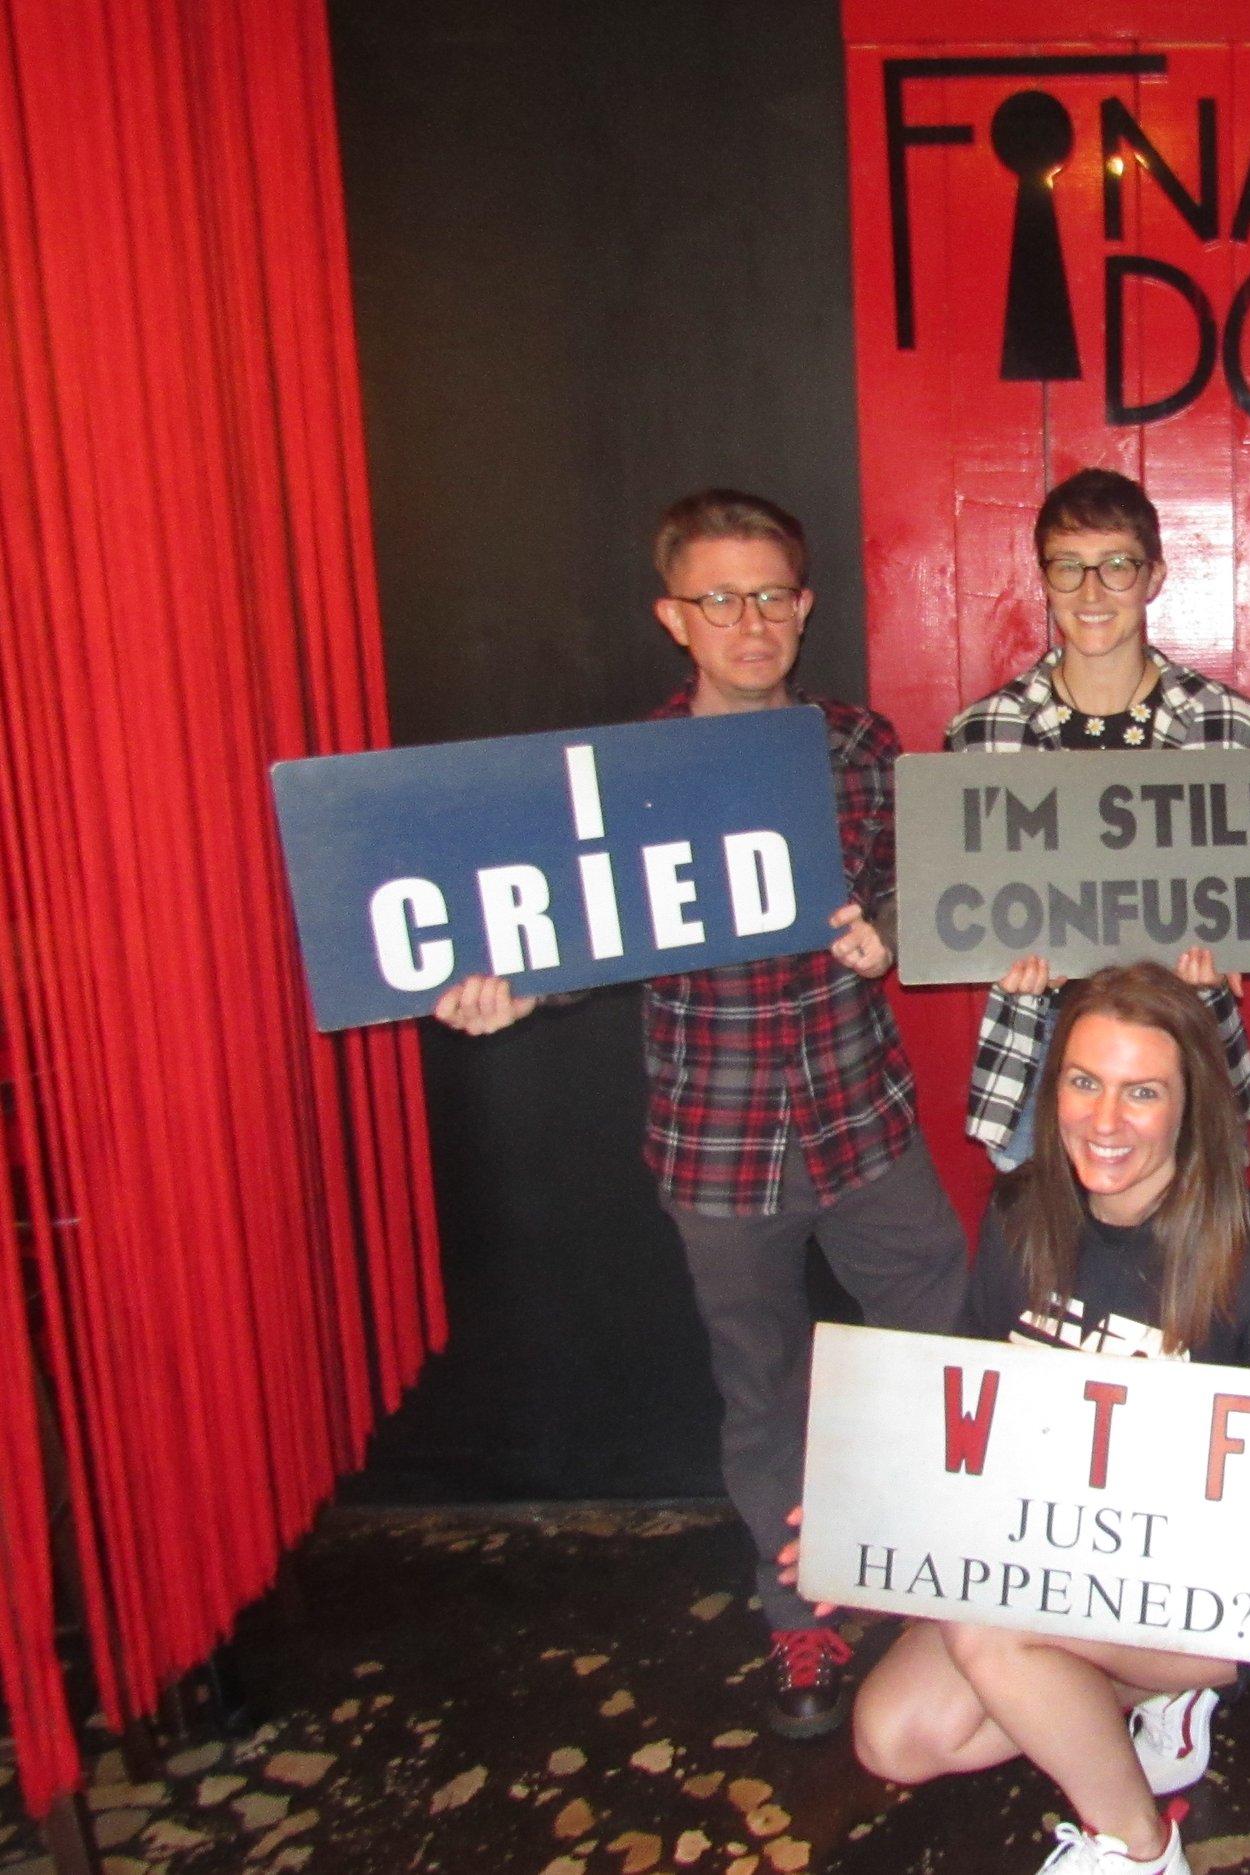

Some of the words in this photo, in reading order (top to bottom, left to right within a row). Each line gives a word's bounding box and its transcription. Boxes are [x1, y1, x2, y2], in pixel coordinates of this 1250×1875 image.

[565, 745, 604, 840] I
[963, 786, 1059, 852] I'M
[370, 830, 797, 992] CRIED
[1008, 1498, 1168, 1558] JUST
